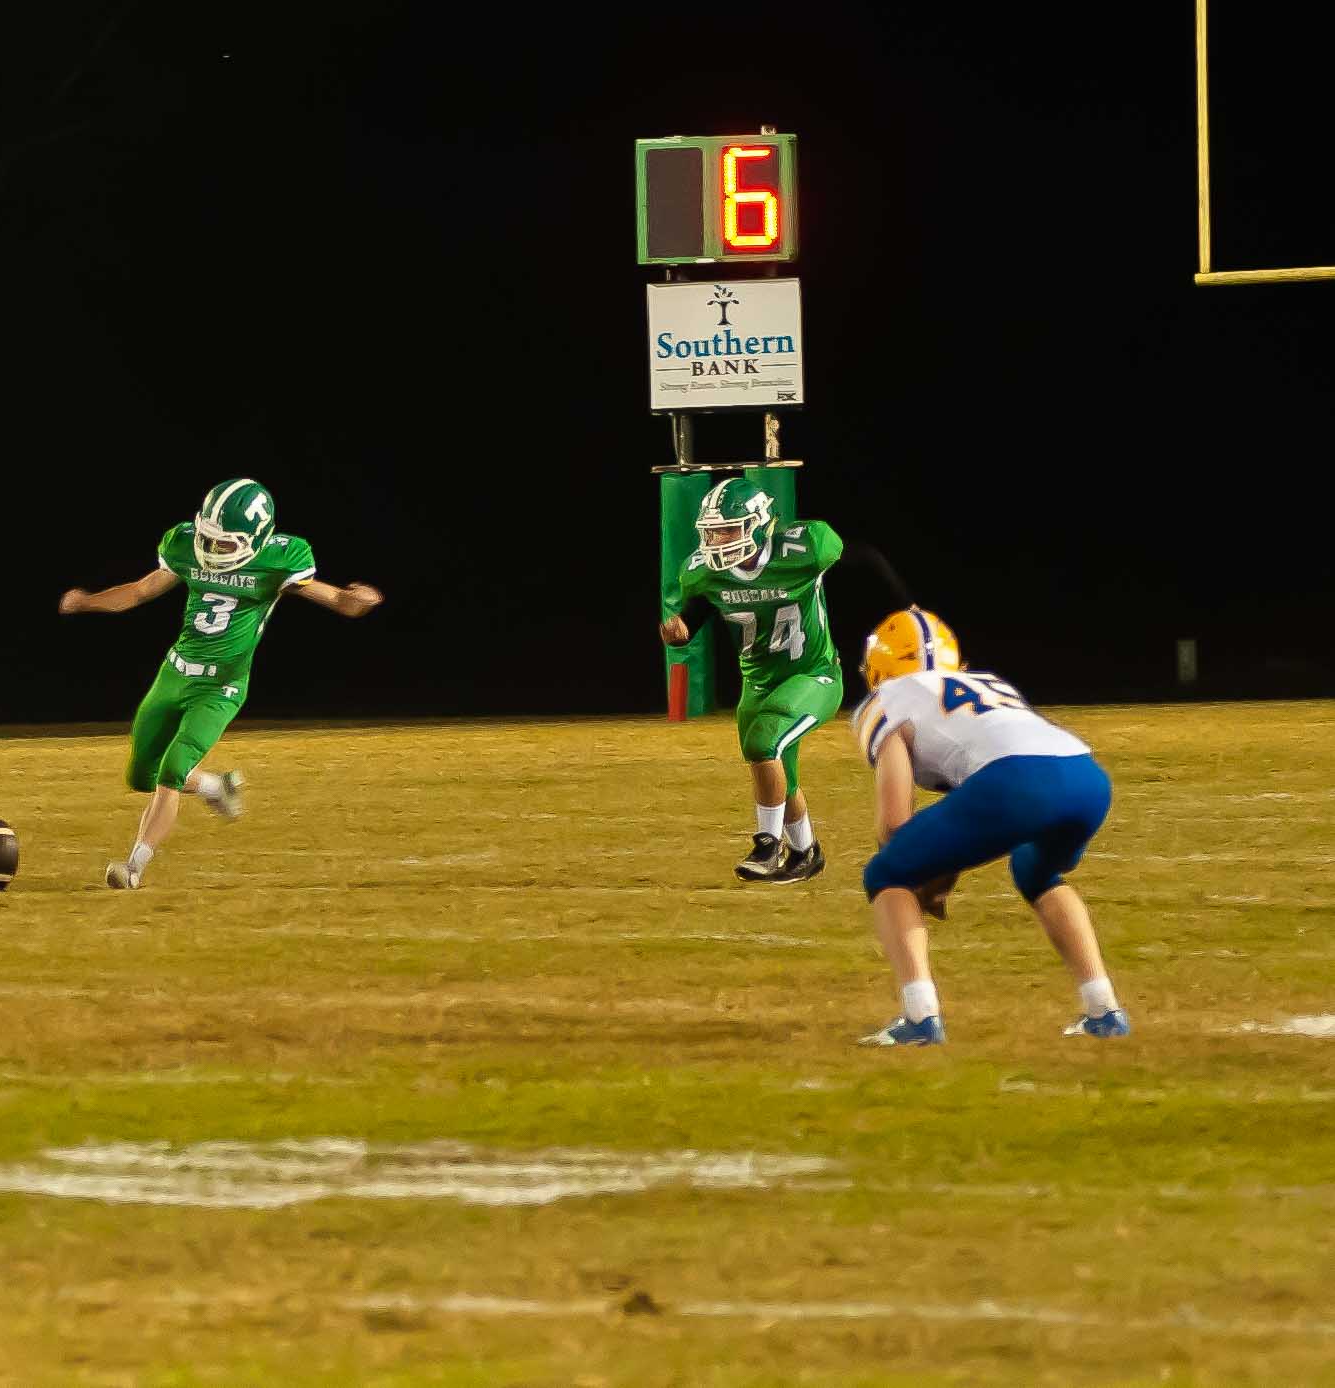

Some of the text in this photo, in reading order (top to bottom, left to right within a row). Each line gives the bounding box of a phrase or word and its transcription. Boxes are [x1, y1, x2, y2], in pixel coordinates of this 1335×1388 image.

[722, 146, 778, 247] 6
[657, 330, 794, 359] Southern
[691, 359, 761, 376] BANK
[193, 592, 239, 635] 3
[723, 603, 807, 661] 74
